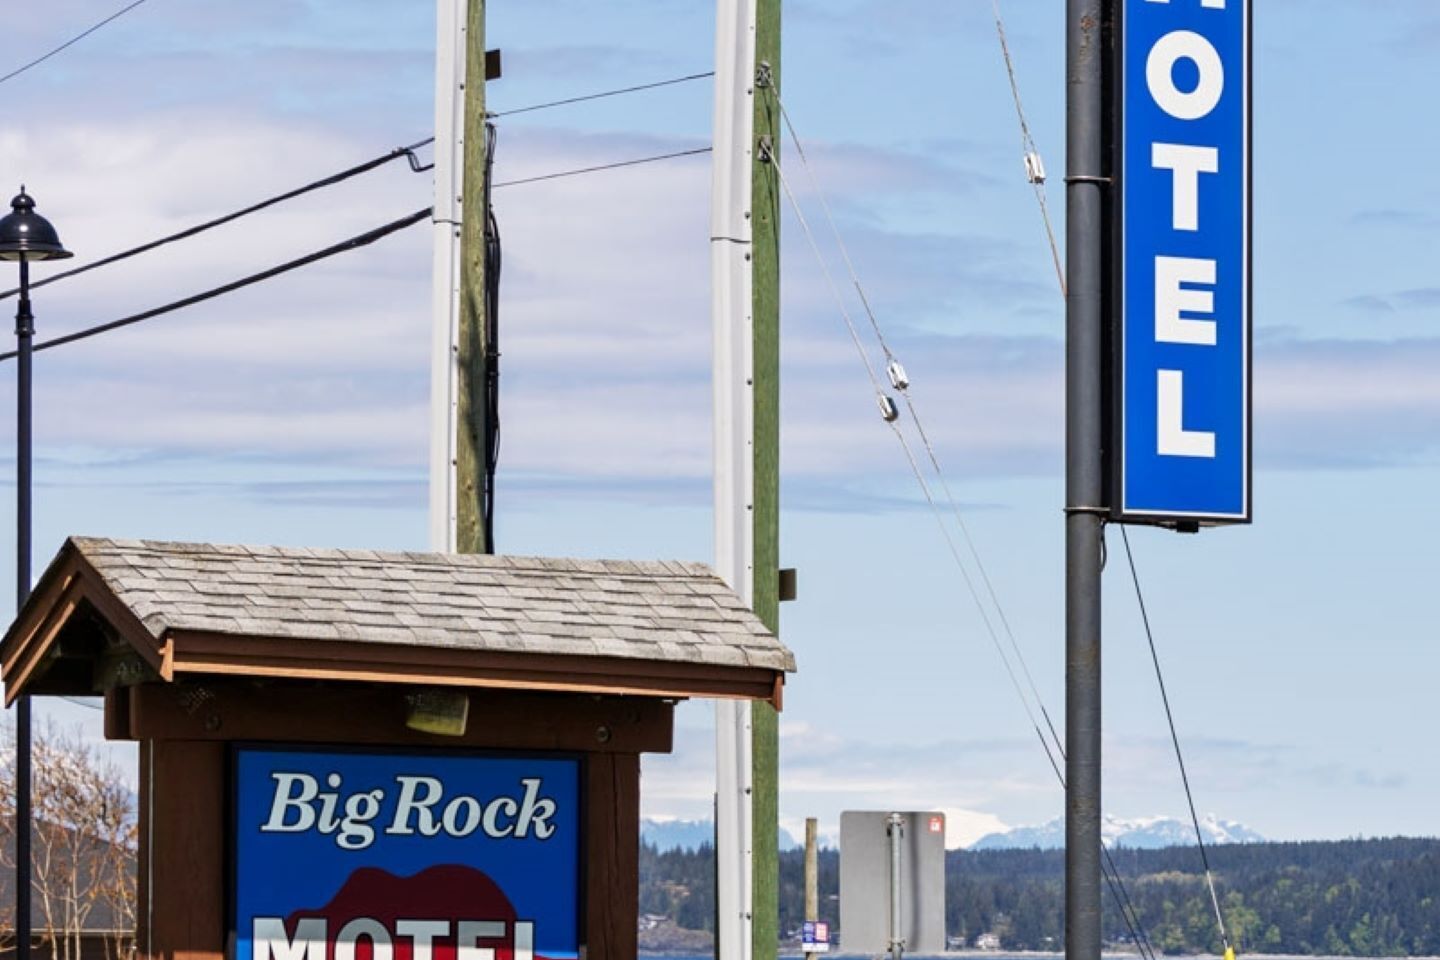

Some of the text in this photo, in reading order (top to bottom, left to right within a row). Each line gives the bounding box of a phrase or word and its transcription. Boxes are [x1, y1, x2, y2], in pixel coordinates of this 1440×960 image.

[1144, 0, 1226, 459] OTEL
[260, 771, 557, 850] Big Rock
